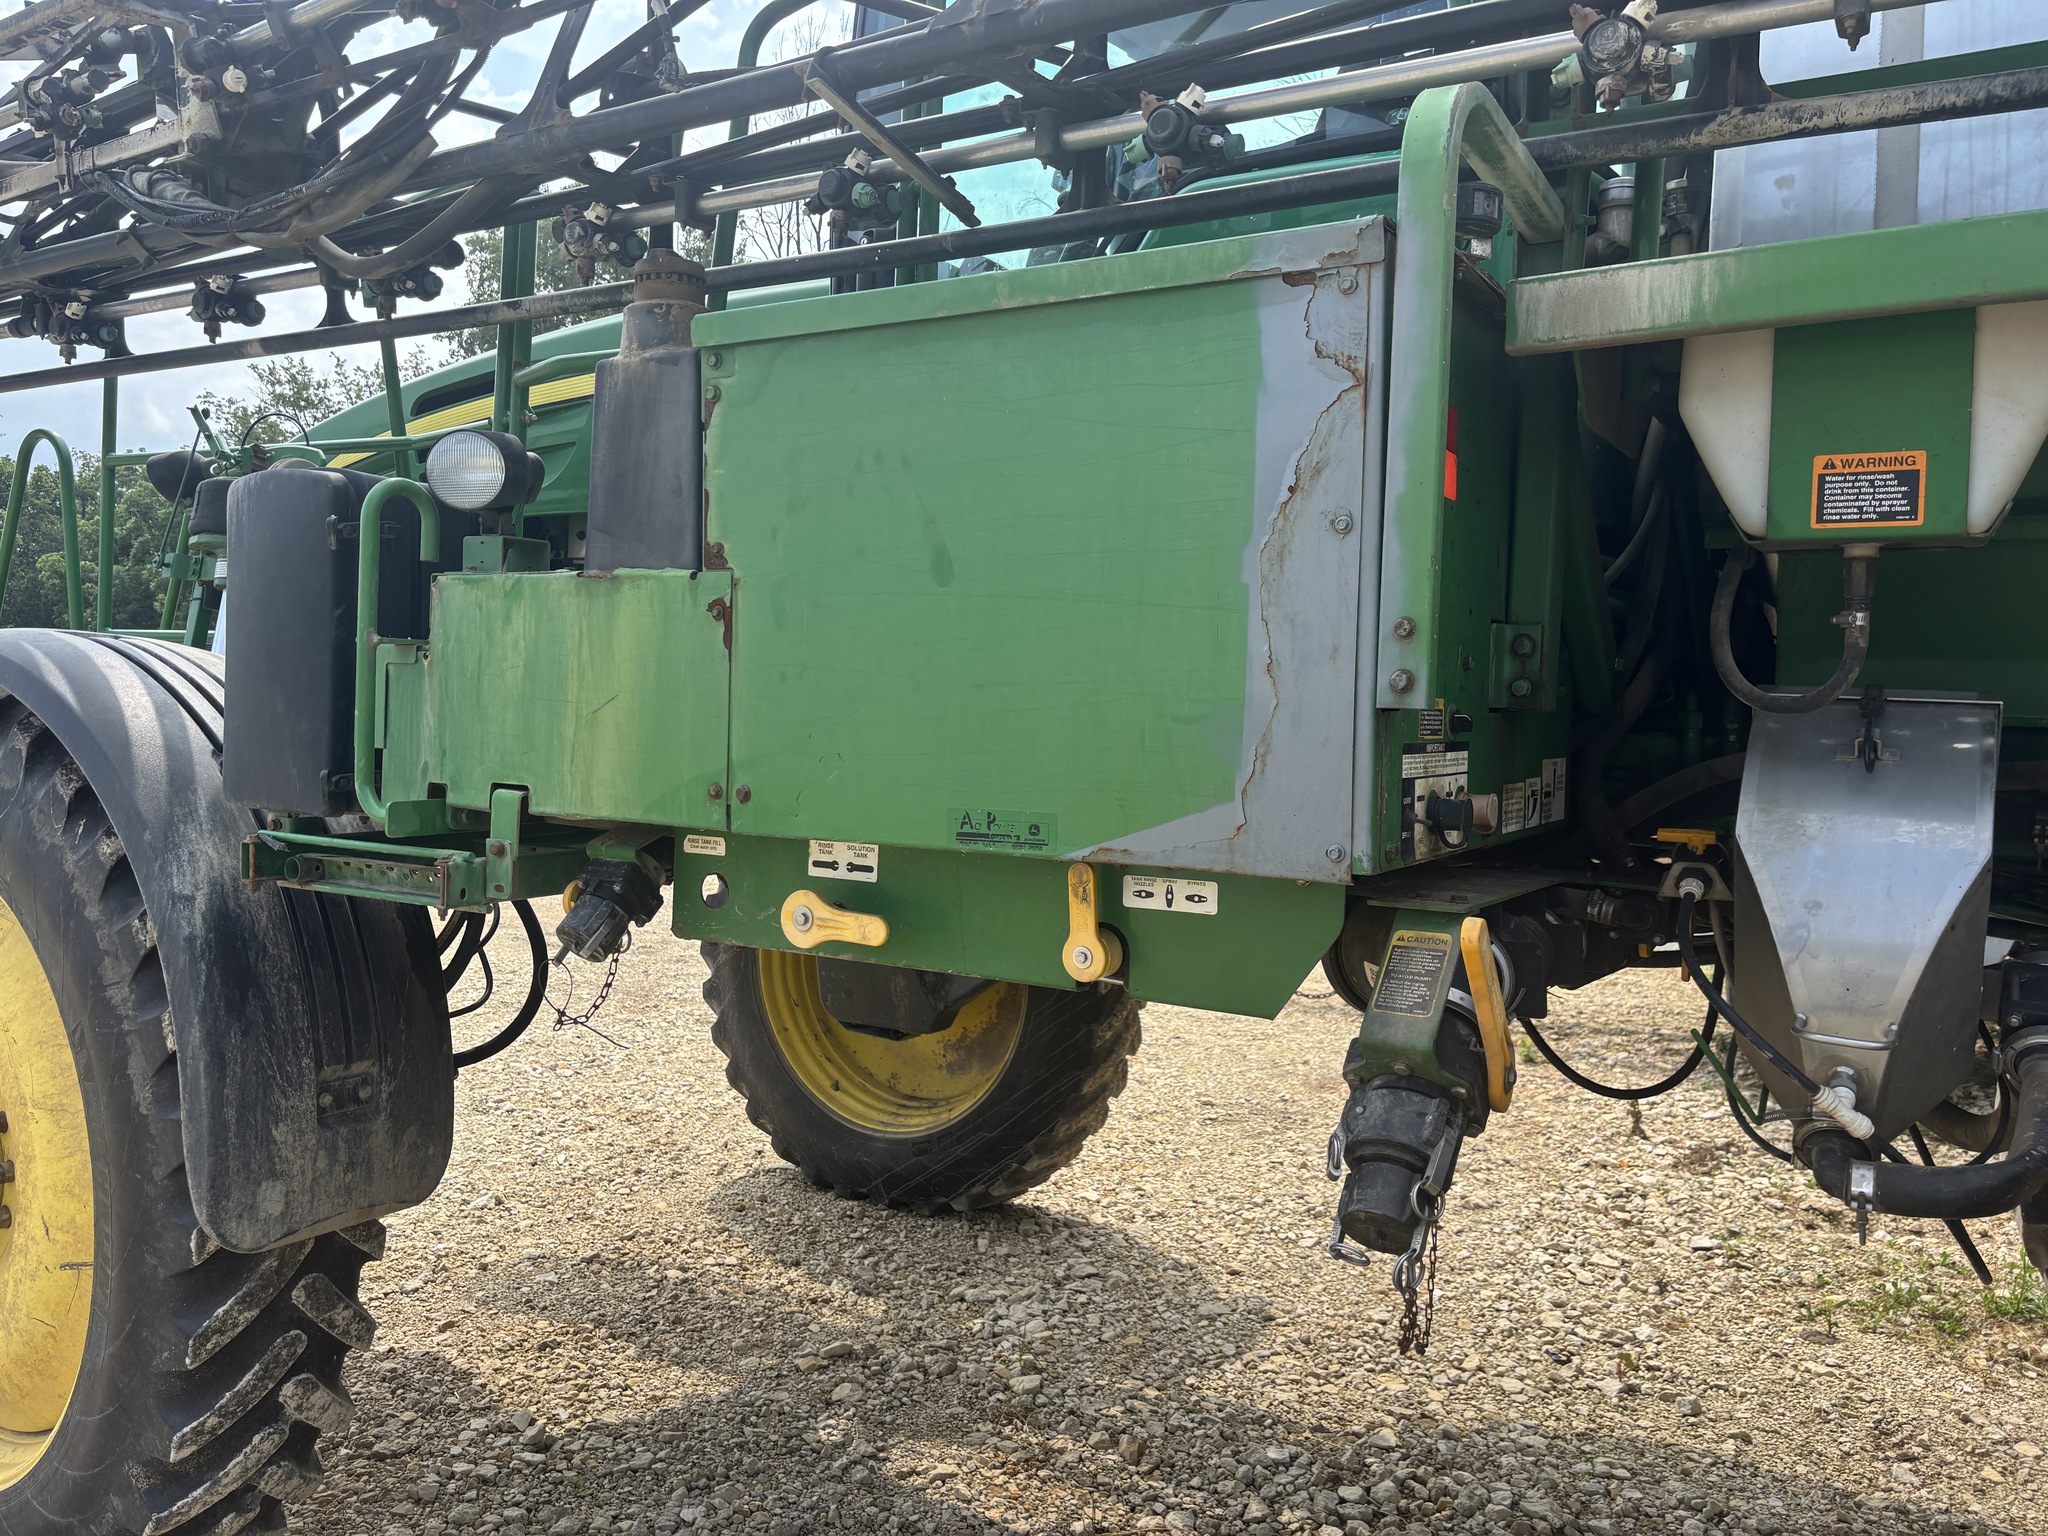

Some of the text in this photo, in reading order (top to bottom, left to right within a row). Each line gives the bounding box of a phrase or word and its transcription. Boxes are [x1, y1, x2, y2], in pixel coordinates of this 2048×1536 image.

[1840, 455, 1916, 469] WARNING
[847, 844, 875, 853] SOLUTION
[1407, 935, 1448, 945] CAUTION
